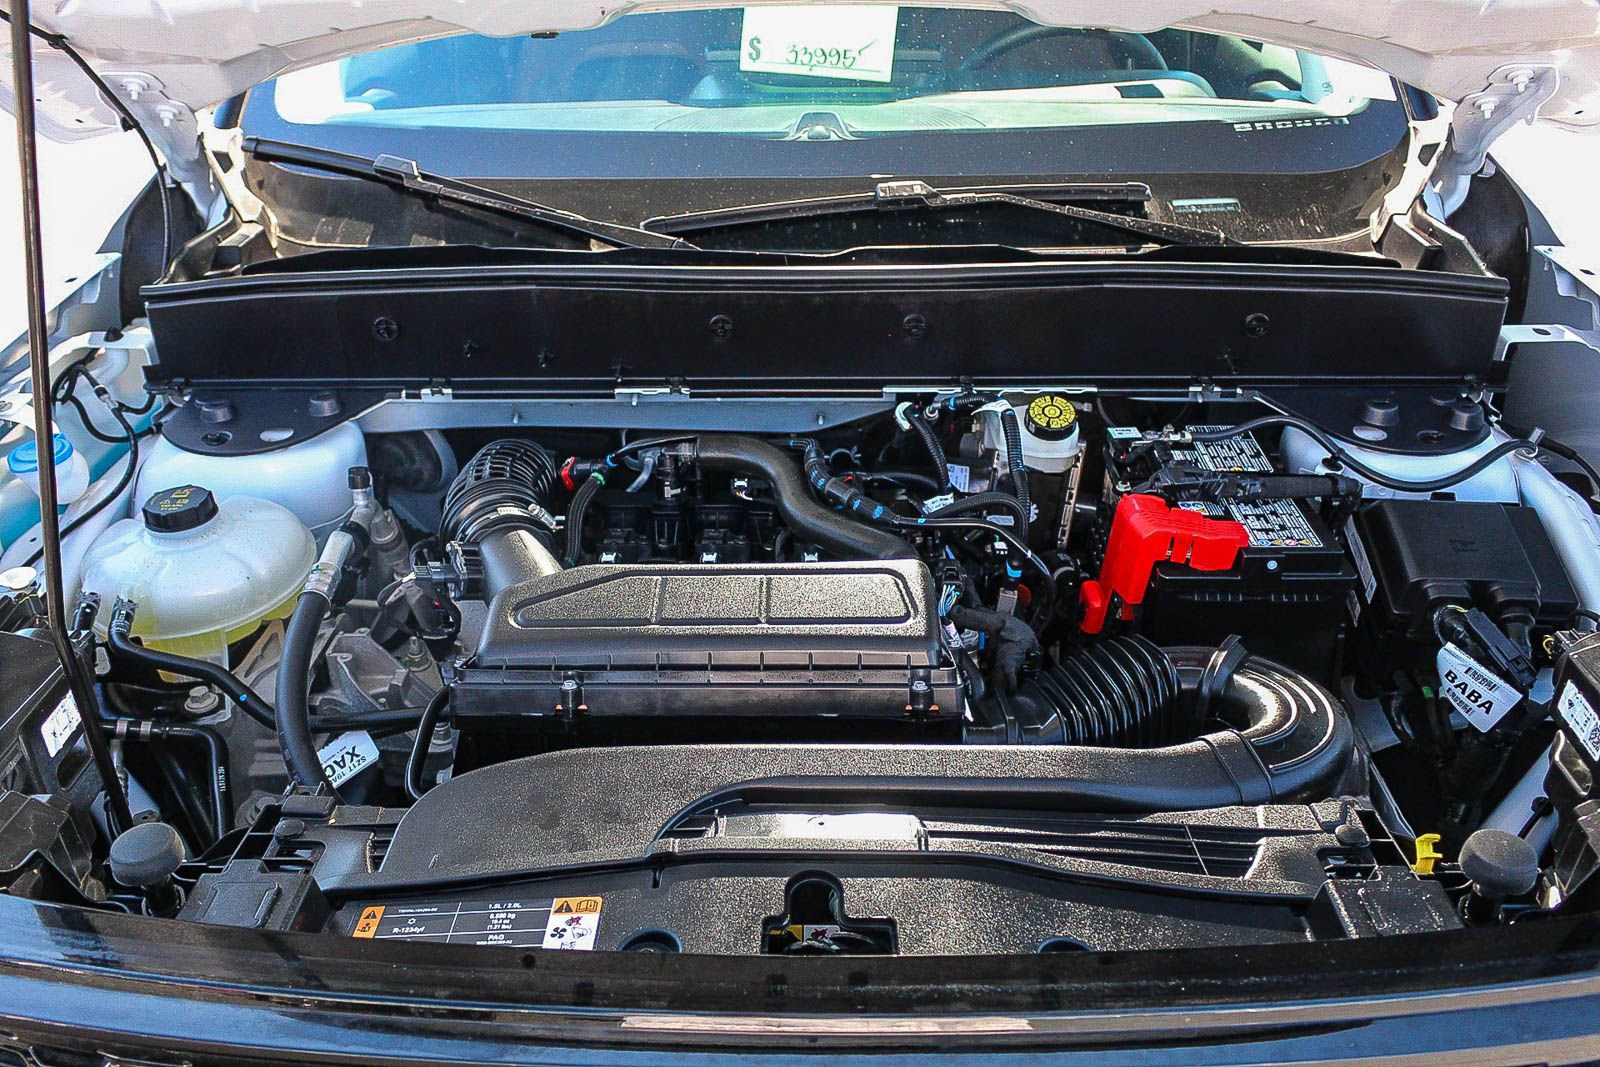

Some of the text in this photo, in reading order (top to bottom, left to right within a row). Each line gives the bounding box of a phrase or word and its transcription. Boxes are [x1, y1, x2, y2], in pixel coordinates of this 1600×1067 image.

[748, 36, 761, 62] $
[1444, 669, 1495, 715] BABA
[392, 926, 425, 934] R-1234yf
